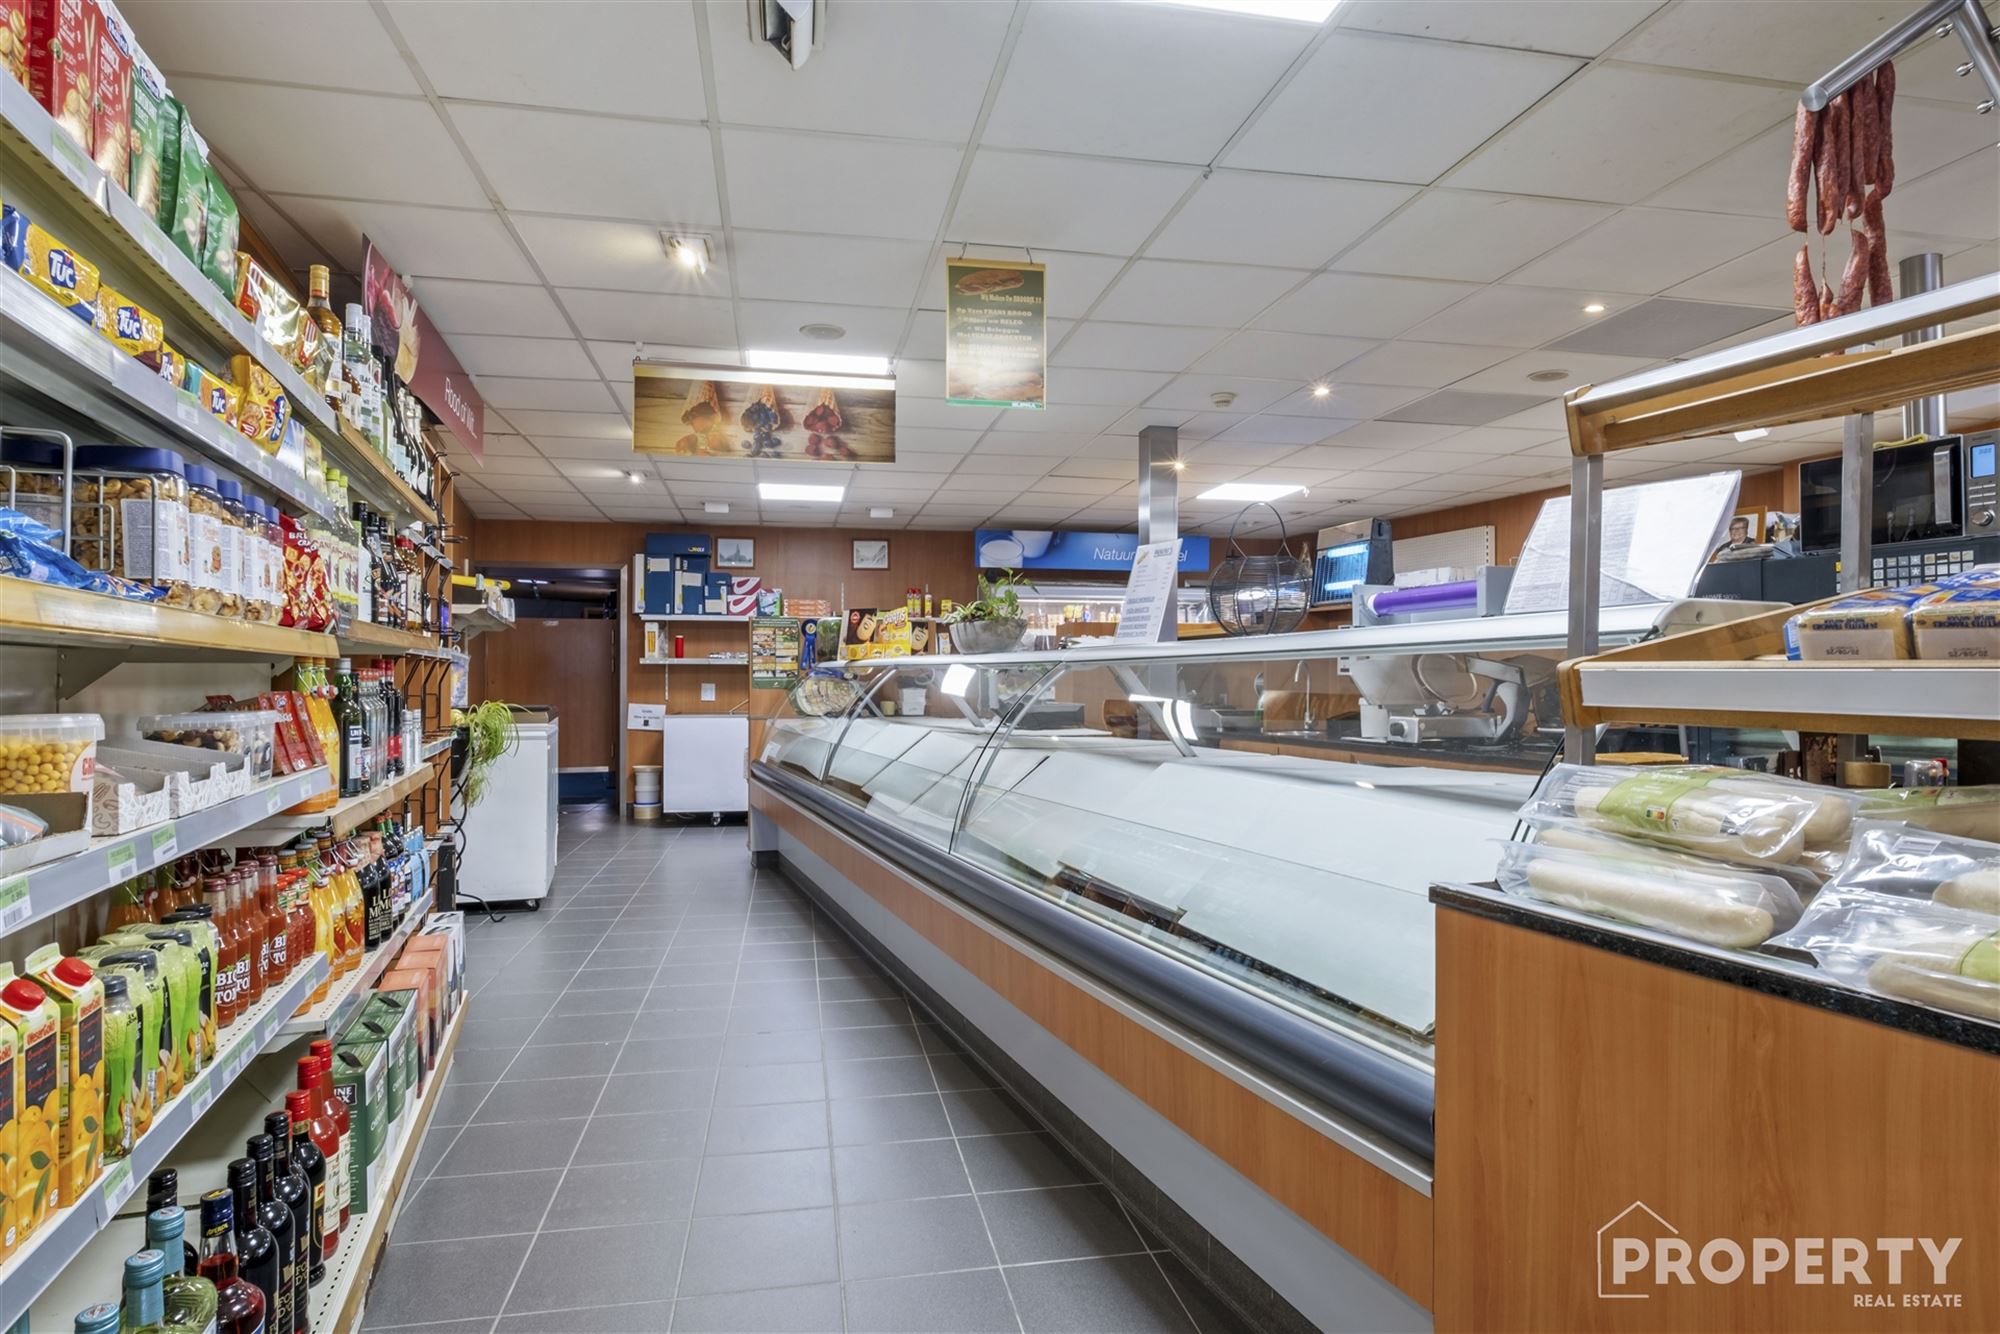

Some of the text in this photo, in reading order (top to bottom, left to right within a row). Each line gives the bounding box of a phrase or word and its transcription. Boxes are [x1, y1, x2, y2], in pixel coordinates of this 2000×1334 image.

[50, 251, 75, 289] TUC
[118, 308, 141, 340] TUC
[212, 391, 225, 413] TUC
